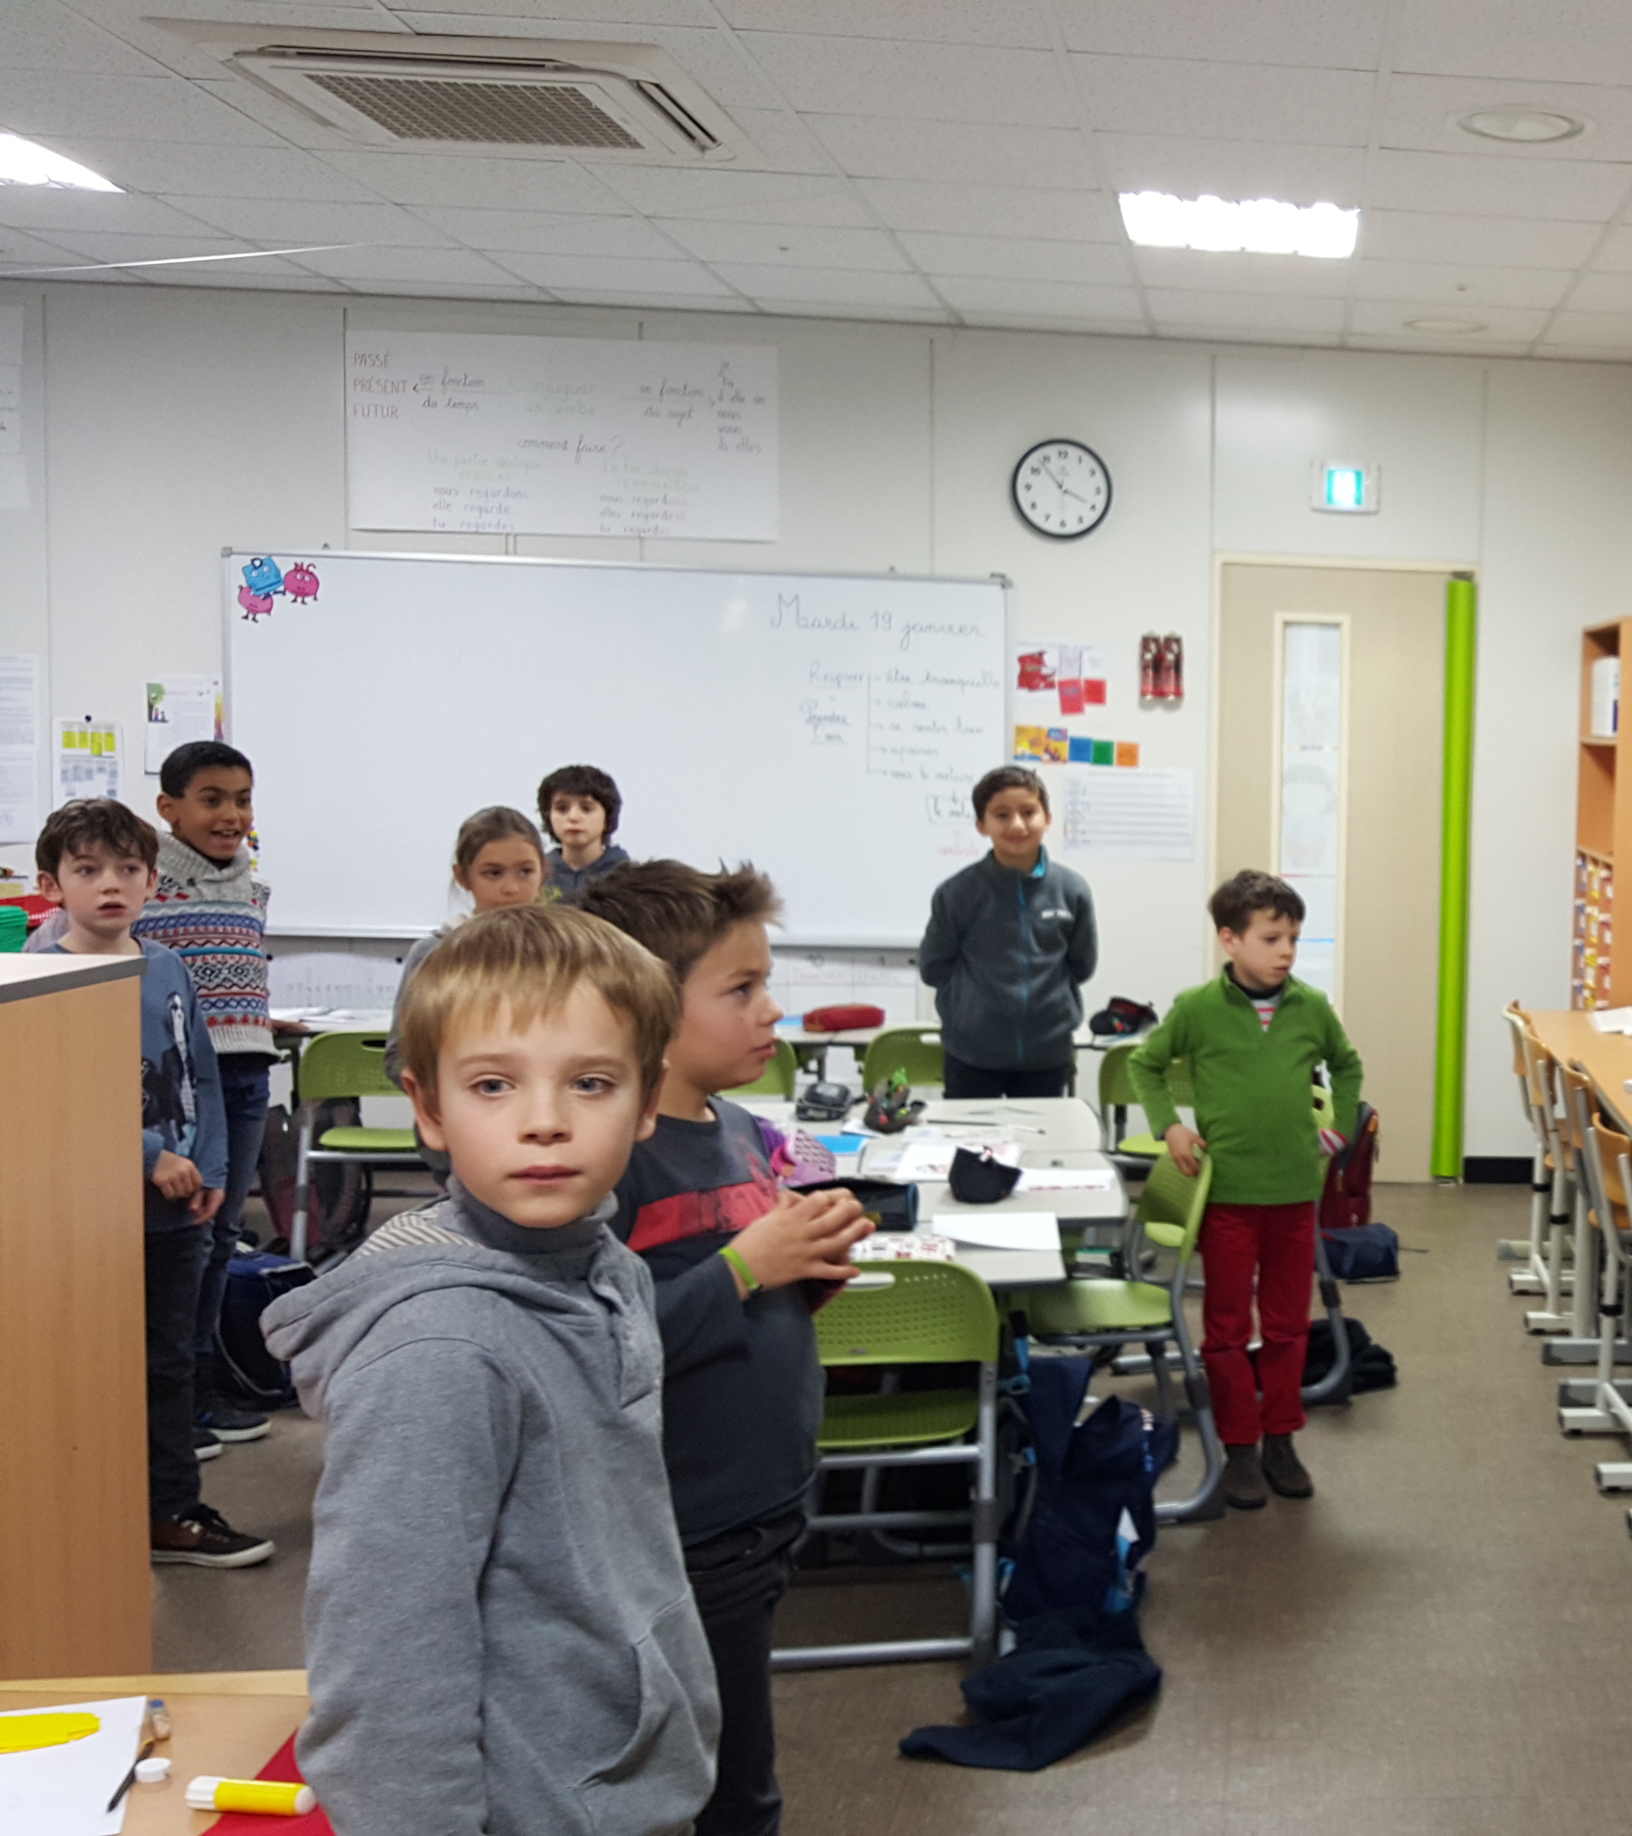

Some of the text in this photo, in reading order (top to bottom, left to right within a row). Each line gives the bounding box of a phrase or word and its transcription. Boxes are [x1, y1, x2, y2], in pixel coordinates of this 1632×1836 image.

[353, 350, 391, 368] PASSÉ
[353, 375, 407, 394] PRÉSENT
[441, 365, 486, 395] fonction
[353, 402, 399, 419] FUTUR
[517, 438, 569, 454] comment
[1058, 449, 1069, 459] 12
[770, 593, 985, 651] Mardi 19 janvier
